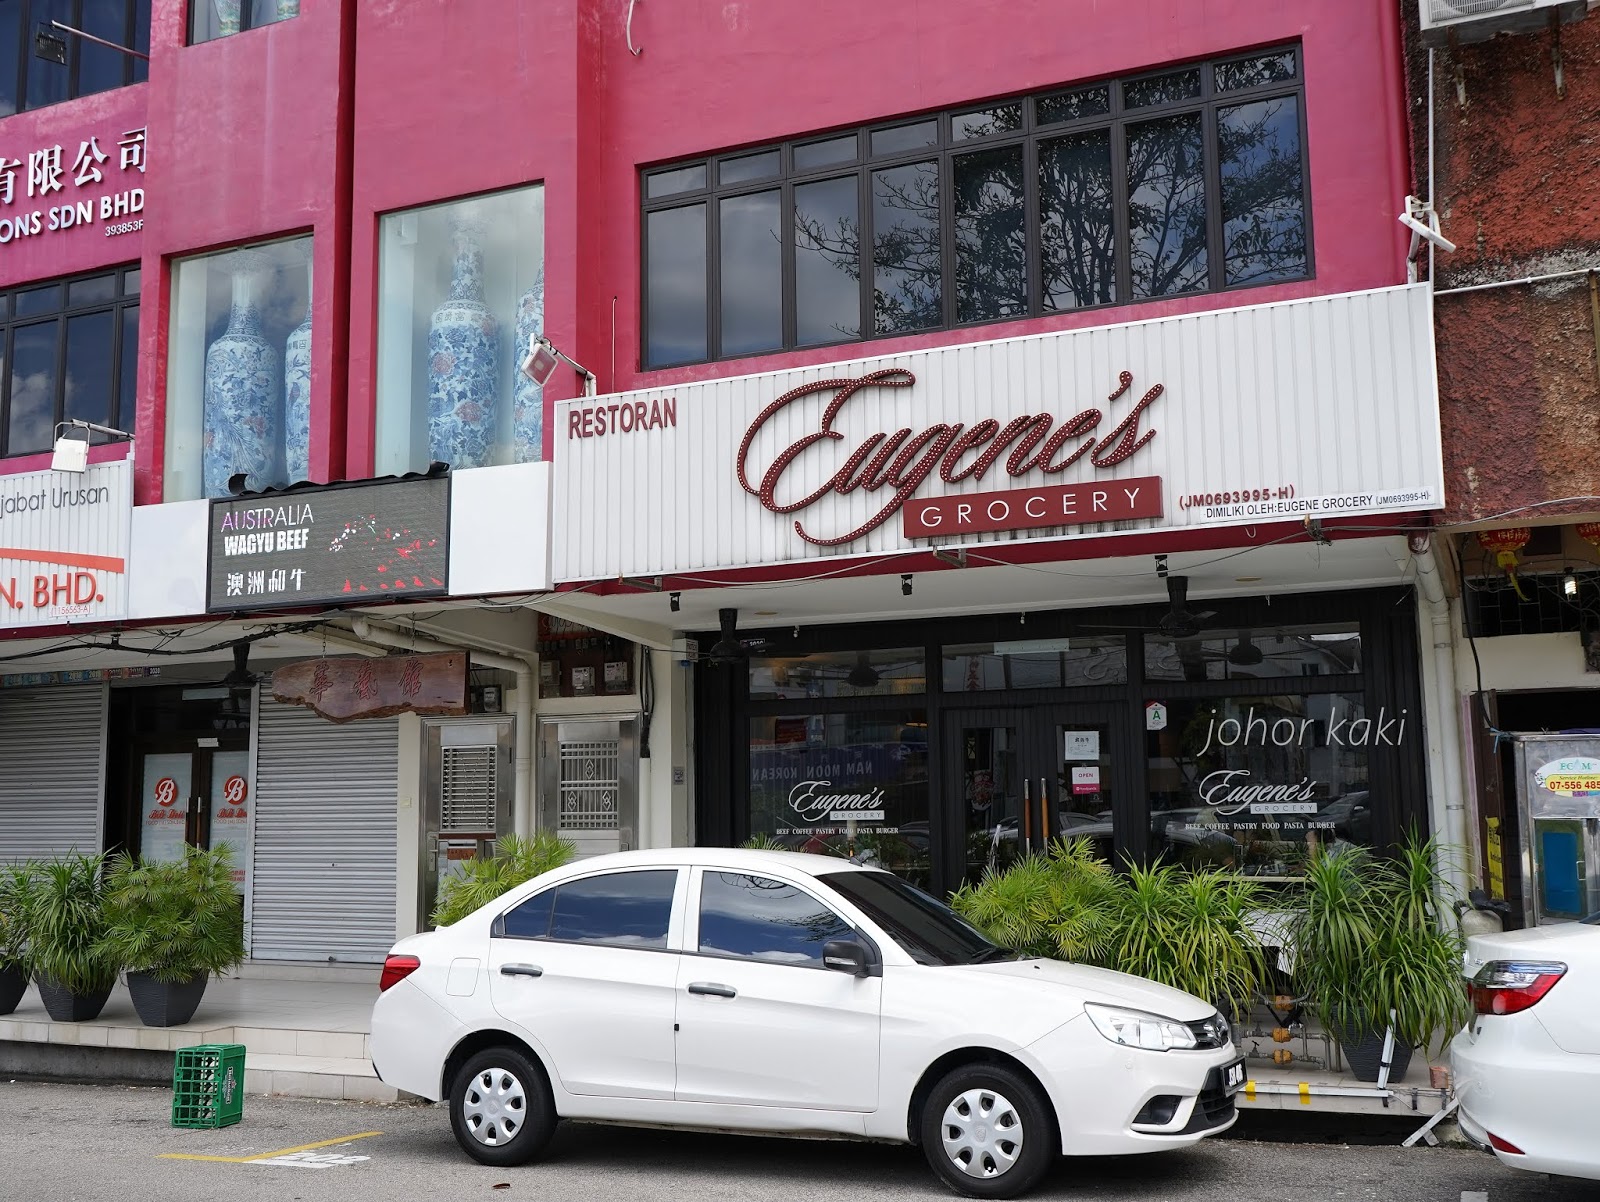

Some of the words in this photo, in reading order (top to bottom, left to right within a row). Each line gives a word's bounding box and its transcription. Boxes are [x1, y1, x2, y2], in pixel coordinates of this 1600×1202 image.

[48, 199, 93, 231] SDN
[100, 188, 145, 219] BHD
[569, 397, 677, 440] RESTORAN
[737, 368, 1165, 546] Eugene's
[52, 486, 109, 509] Urusan
[920, 487, 1140, 528] GROCERY
[1179, 484, 1295, 511] (JM0693995-H)
[1206, 505, 1245, 518] DIMILIKI
[1322, 495, 1373, 508] GROCERY
[220, 503, 315, 533] AUSTRALIA
[224, 531, 275, 556] WAGYU
[276, 528, 310, 551] BEEF
[33, 571, 104, 608] BHD.
[1152, 710, 1161, 720] A
[1198, 769, 1317, 816] Eugene's
[1549, 781, 1582, 790] 07-556
[788, 780, 885, 822] Eugene's
[1254, 804, 1315, 813] GROCERY
[1233, 822, 1258, 830] PASTRY
[1261, 822, 1281, 830] FOOD
[1307, 821, 1336, 829] BURGER
